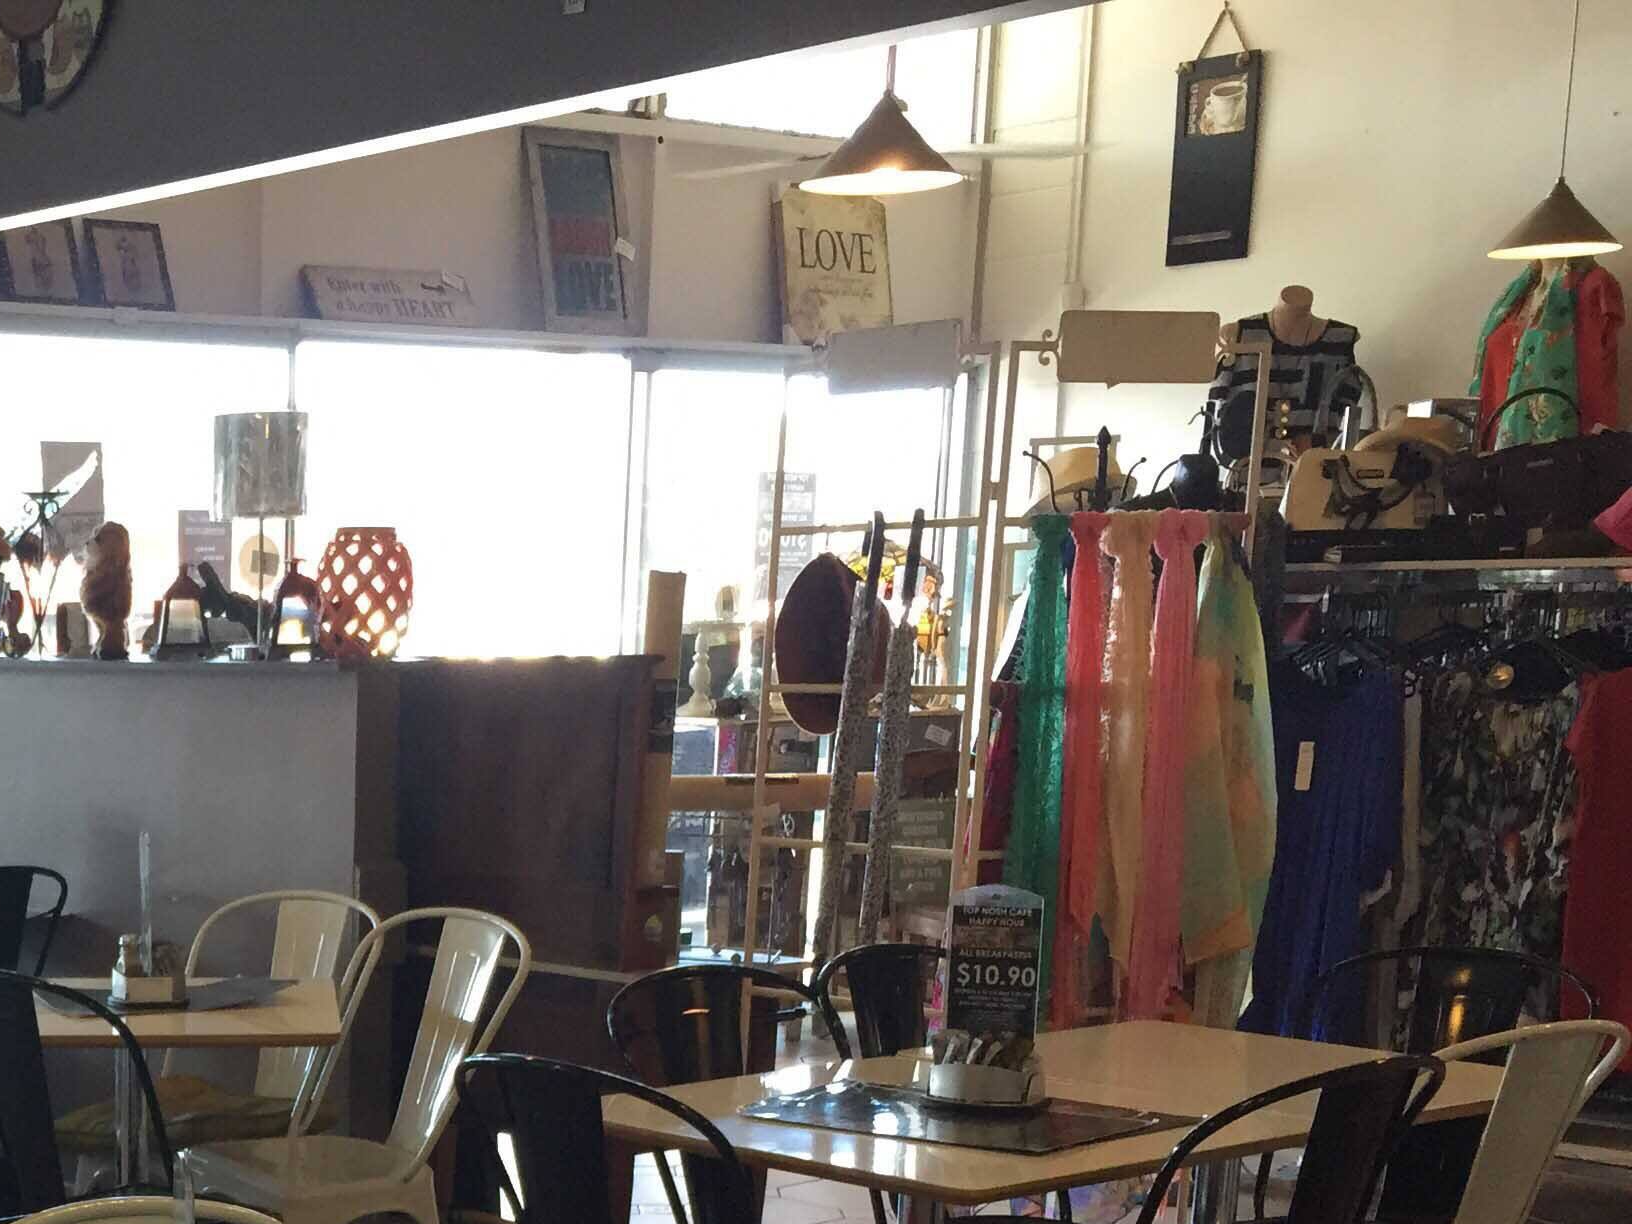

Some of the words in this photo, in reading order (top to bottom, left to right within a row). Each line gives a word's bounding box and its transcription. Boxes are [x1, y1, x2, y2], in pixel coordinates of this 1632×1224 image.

[796, 226, 877, 274] LOVE
[392, 298, 456, 319] HEART
[968, 917, 998, 926] HAPPY
[956, 962, 1036, 988] $10.90
